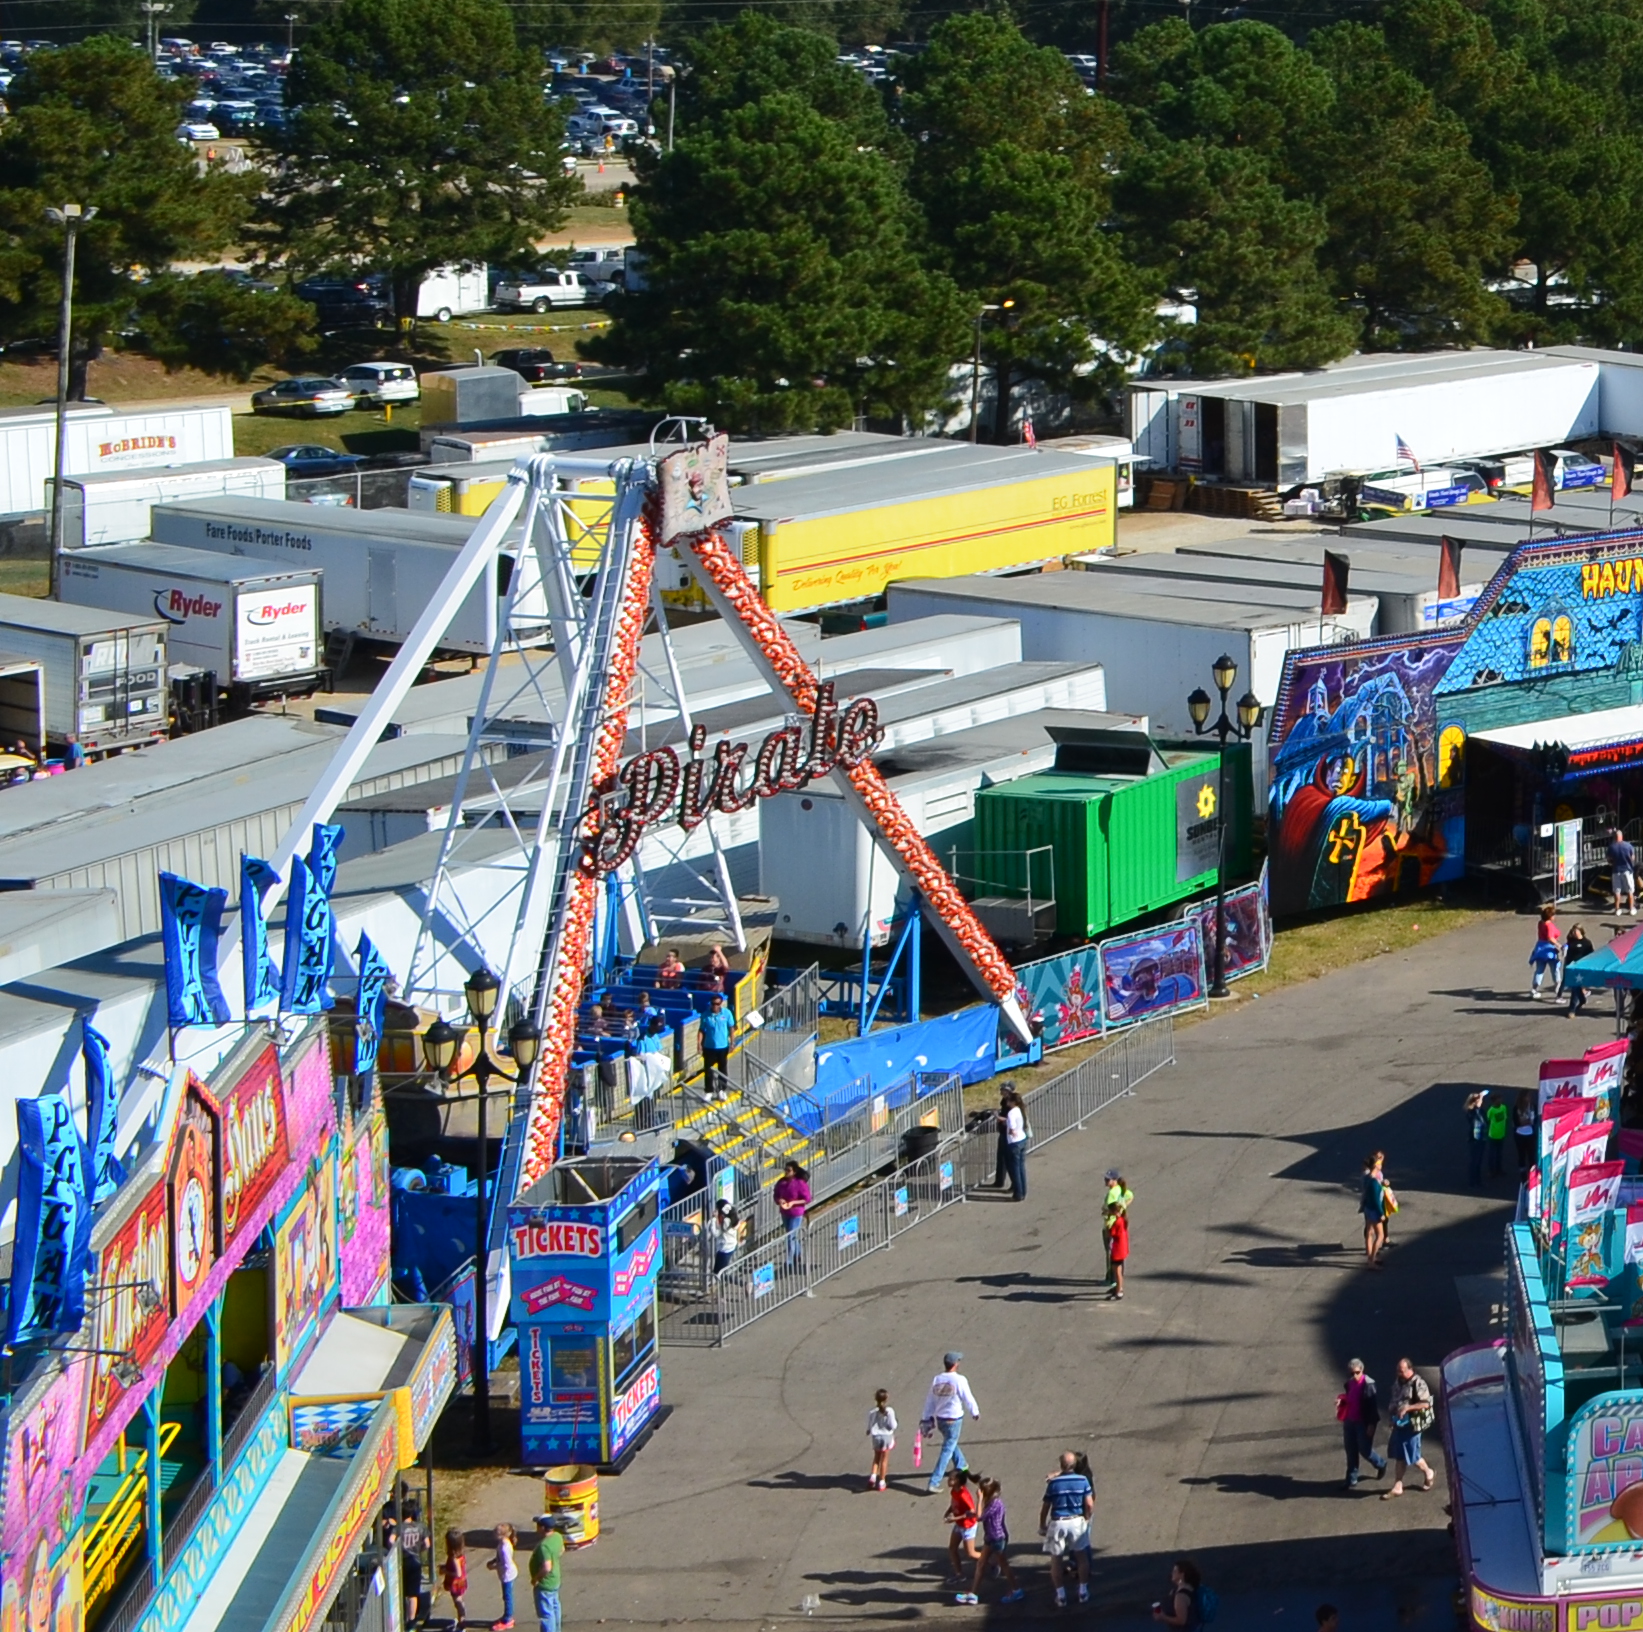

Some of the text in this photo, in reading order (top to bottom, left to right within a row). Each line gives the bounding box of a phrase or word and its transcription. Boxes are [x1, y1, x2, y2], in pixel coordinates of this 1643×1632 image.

[99, 435, 177, 457] McBRIDE'S
[100, 449, 177, 463] CONCESSIONS
[1052, 488, 1107, 510] EG Forrest
[206, 522, 225, 539] Fare
[285, 532, 312, 550] Foods
[169, 589, 222, 618] Ryder
[261, 602, 307, 619] Ryder
[117, 671, 157, 688] FOOD
[582, 681, 886, 872] Pirate
[515, 1224, 600, 1257] TICKETS
[531, 1328, 542, 1402] TICKETS
[616, 1368, 657, 1429] TICKETS
[1499, 1604, 1555, 1632] KONES
[1576, 1601, 1643, 1630] POP
